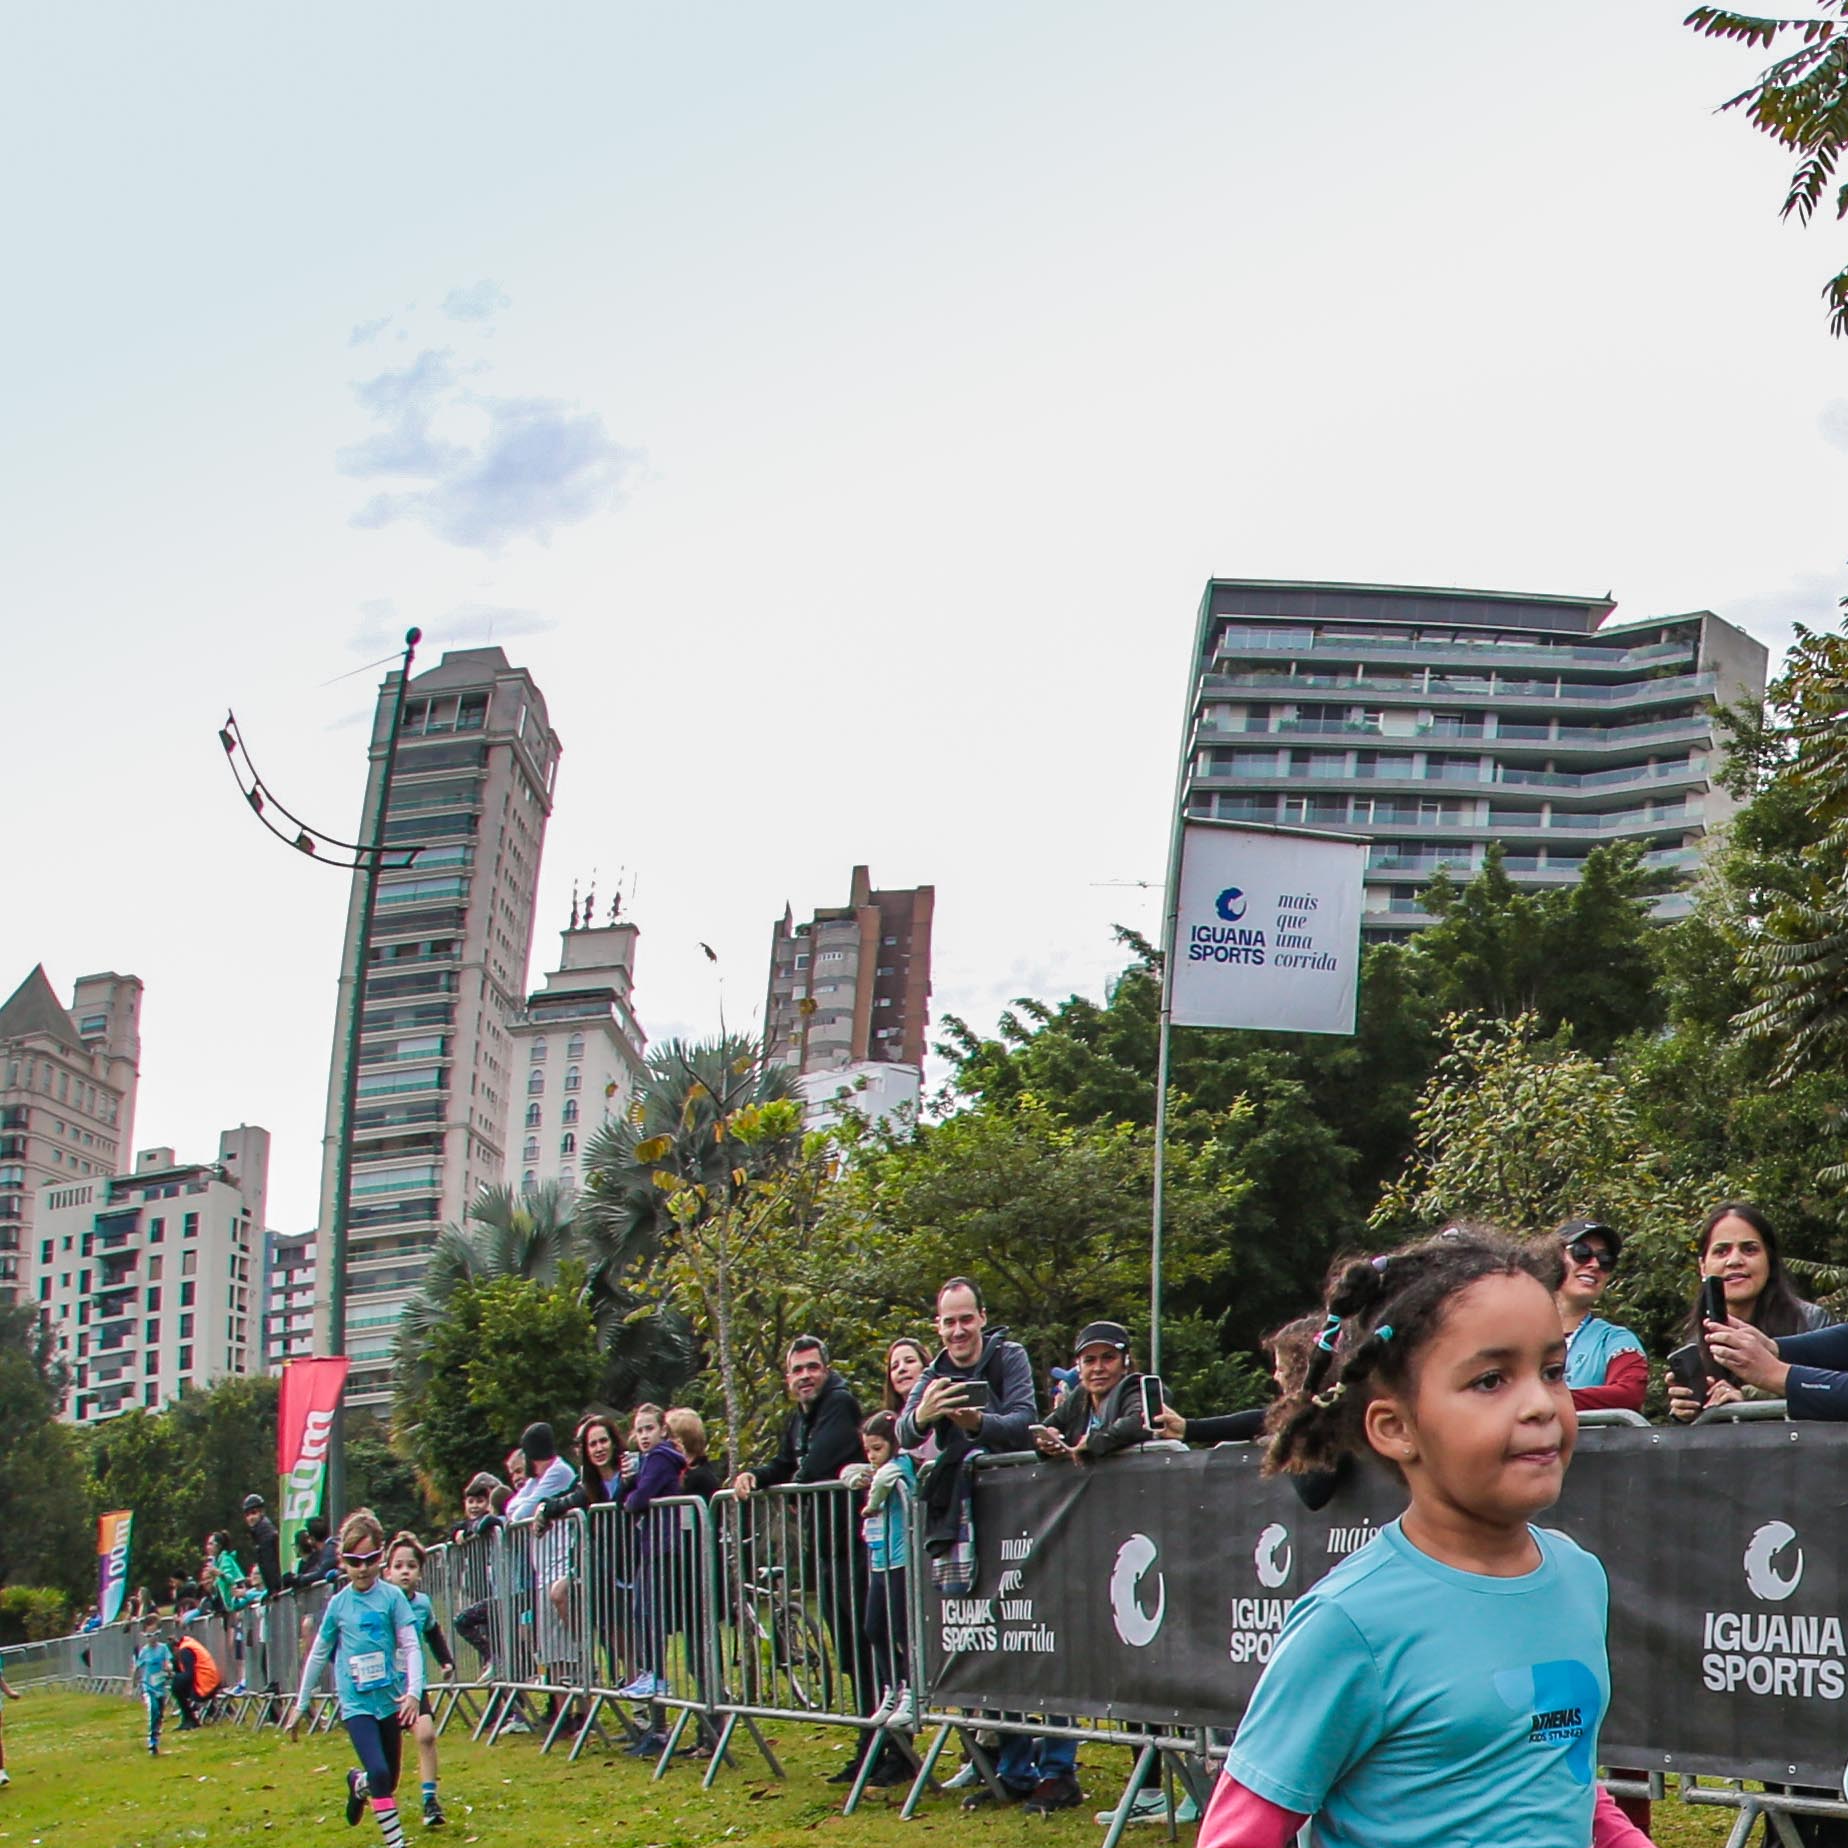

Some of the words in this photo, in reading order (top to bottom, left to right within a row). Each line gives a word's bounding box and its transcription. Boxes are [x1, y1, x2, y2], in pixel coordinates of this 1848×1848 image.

[1278, 892, 1319, 911] mais
[1276, 912, 1307, 932] que
[1191, 925, 1266, 947] IGUANA
[1275, 933, 1312, 949] uma
[1188, 944, 1265, 966] SPORTS
[1274, 952, 1337, 971] corrida
[283, 1407, 335, 1521] 50m
[1000, 1530, 1034, 1560] mais
[941, 1599, 996, 1625] IGUANA
[1231, 1598, 1294, 1630] IGUA
[942, 1625, 998, 1652] SPORTS
[1002, 1623, 1055, 1652] corrida
[1230, 1631, 1279, 1664] SPO
[1703, 1612, 1847, 1657] IGUANA
[1702, 1654, 1846, 1700] SPORTS
[1531, 1707, 1583, 1731] ATHENAS
